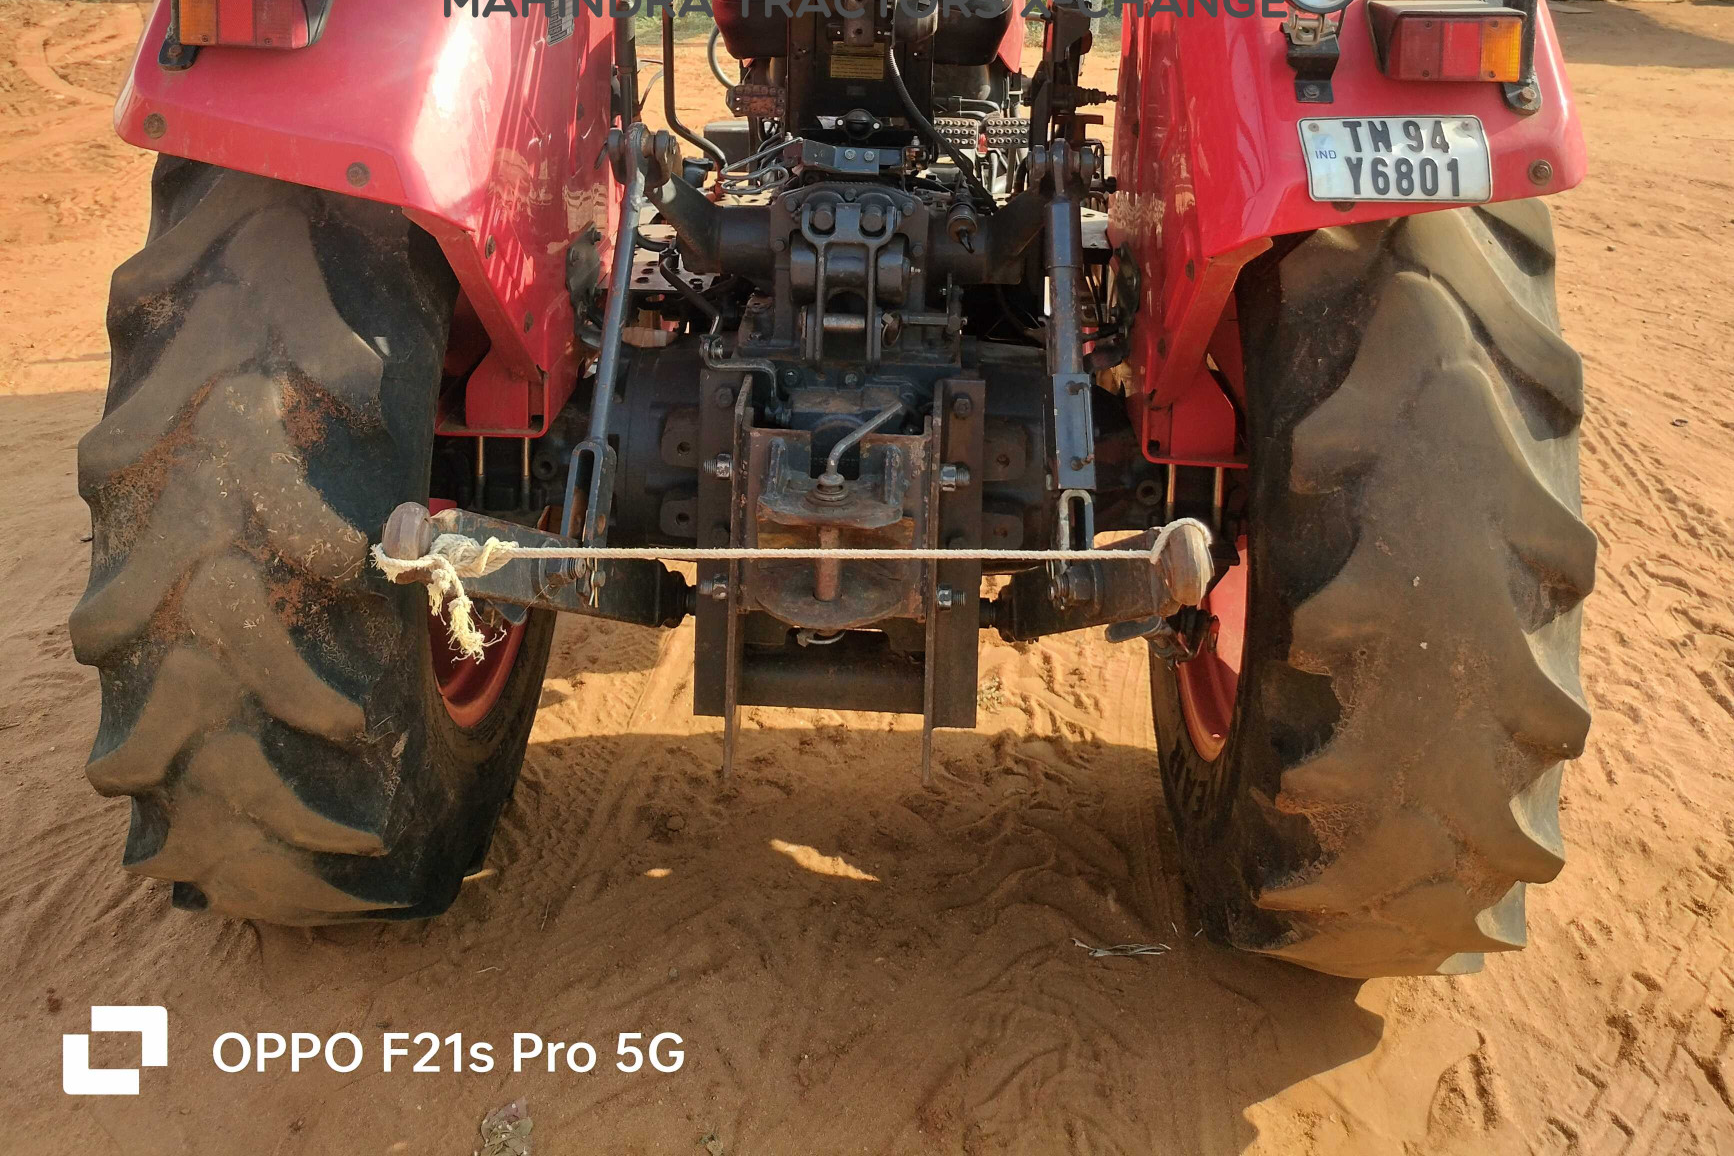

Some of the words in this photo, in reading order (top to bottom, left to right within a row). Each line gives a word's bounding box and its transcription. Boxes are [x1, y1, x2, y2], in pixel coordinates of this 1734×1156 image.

[1342, 120, 1393, 153] TN
[1402, 120, 1450, 154] 94
[1315, 150, 1337, 160] IND
[1344, 156, 1460, 197] Y6801
